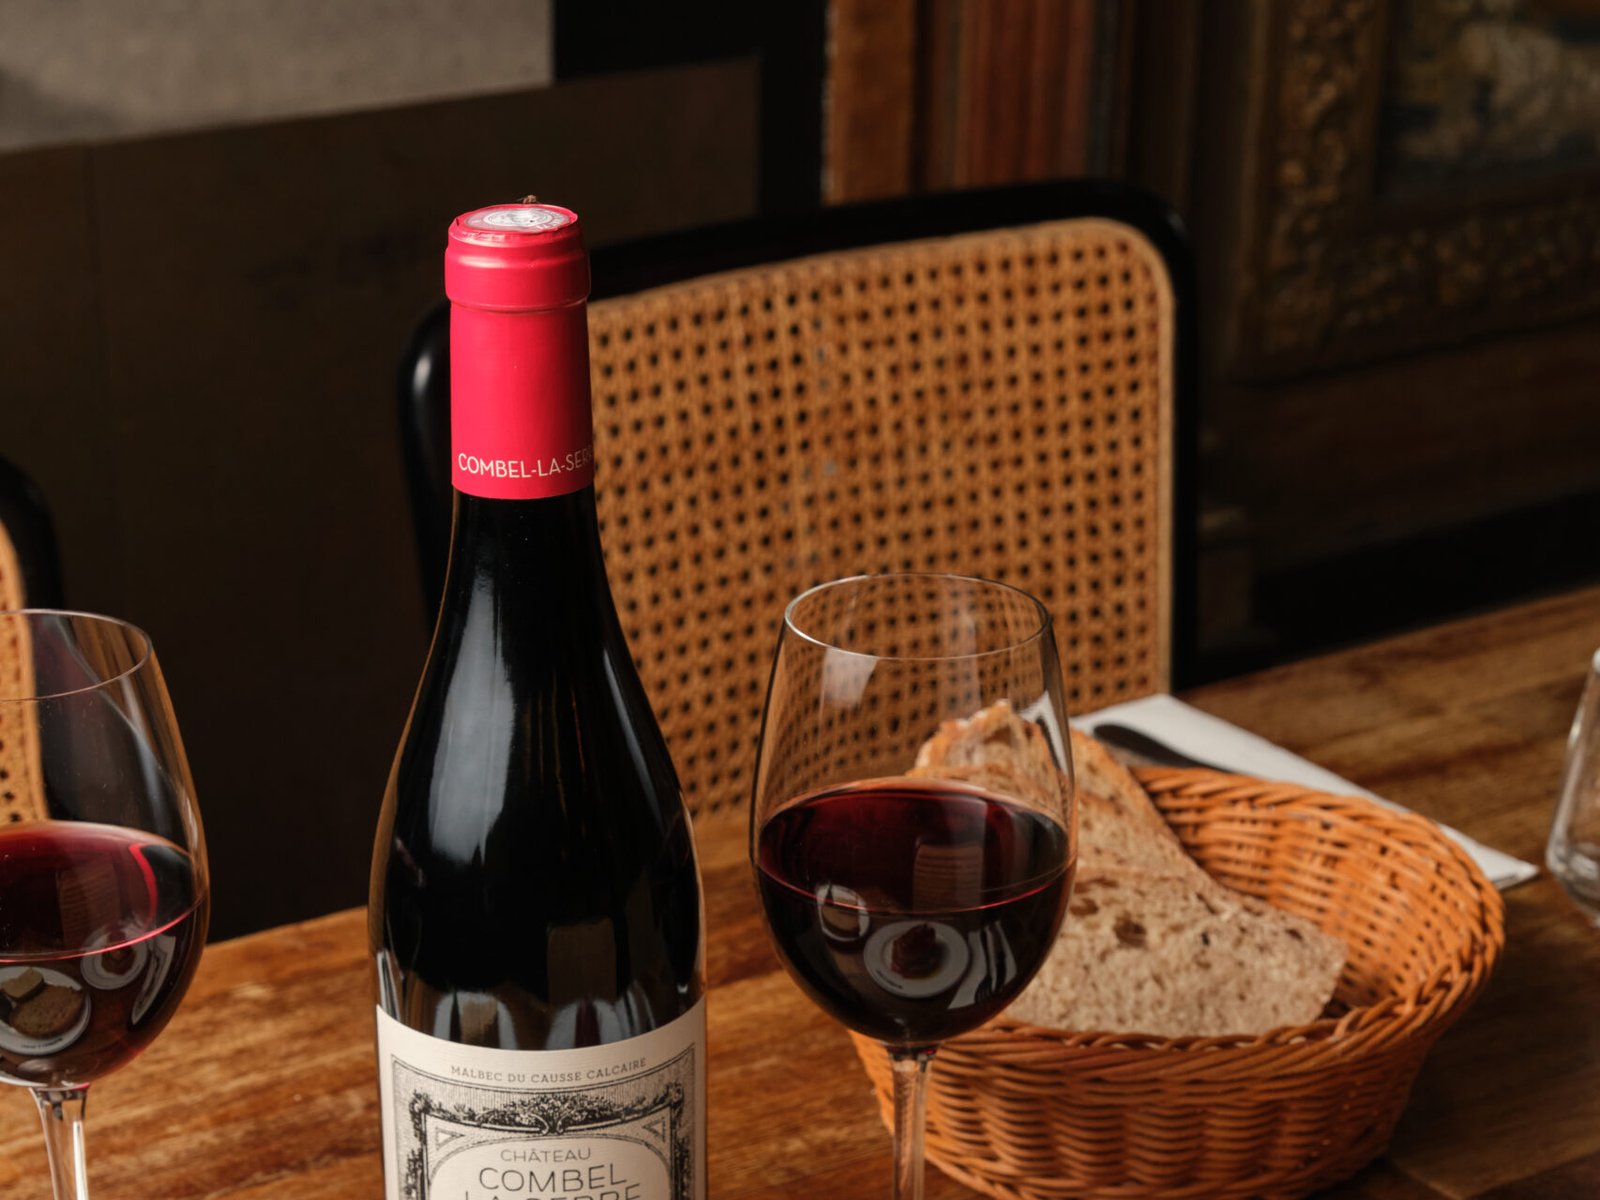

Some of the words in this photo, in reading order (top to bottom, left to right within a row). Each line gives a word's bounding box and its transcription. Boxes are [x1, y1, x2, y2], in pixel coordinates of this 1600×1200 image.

[450, 1064, 503, 1083] MALBEC
[507, 1073, 526, 1083] DU
[530, 1072, 582, 1084] CAUSSE
[586, 1057, 647, 1080] CALCAIRE
[500, 1147, 592, 1163] CHÂTEAU
[479, 1163, 628, 1193] COMBEL
